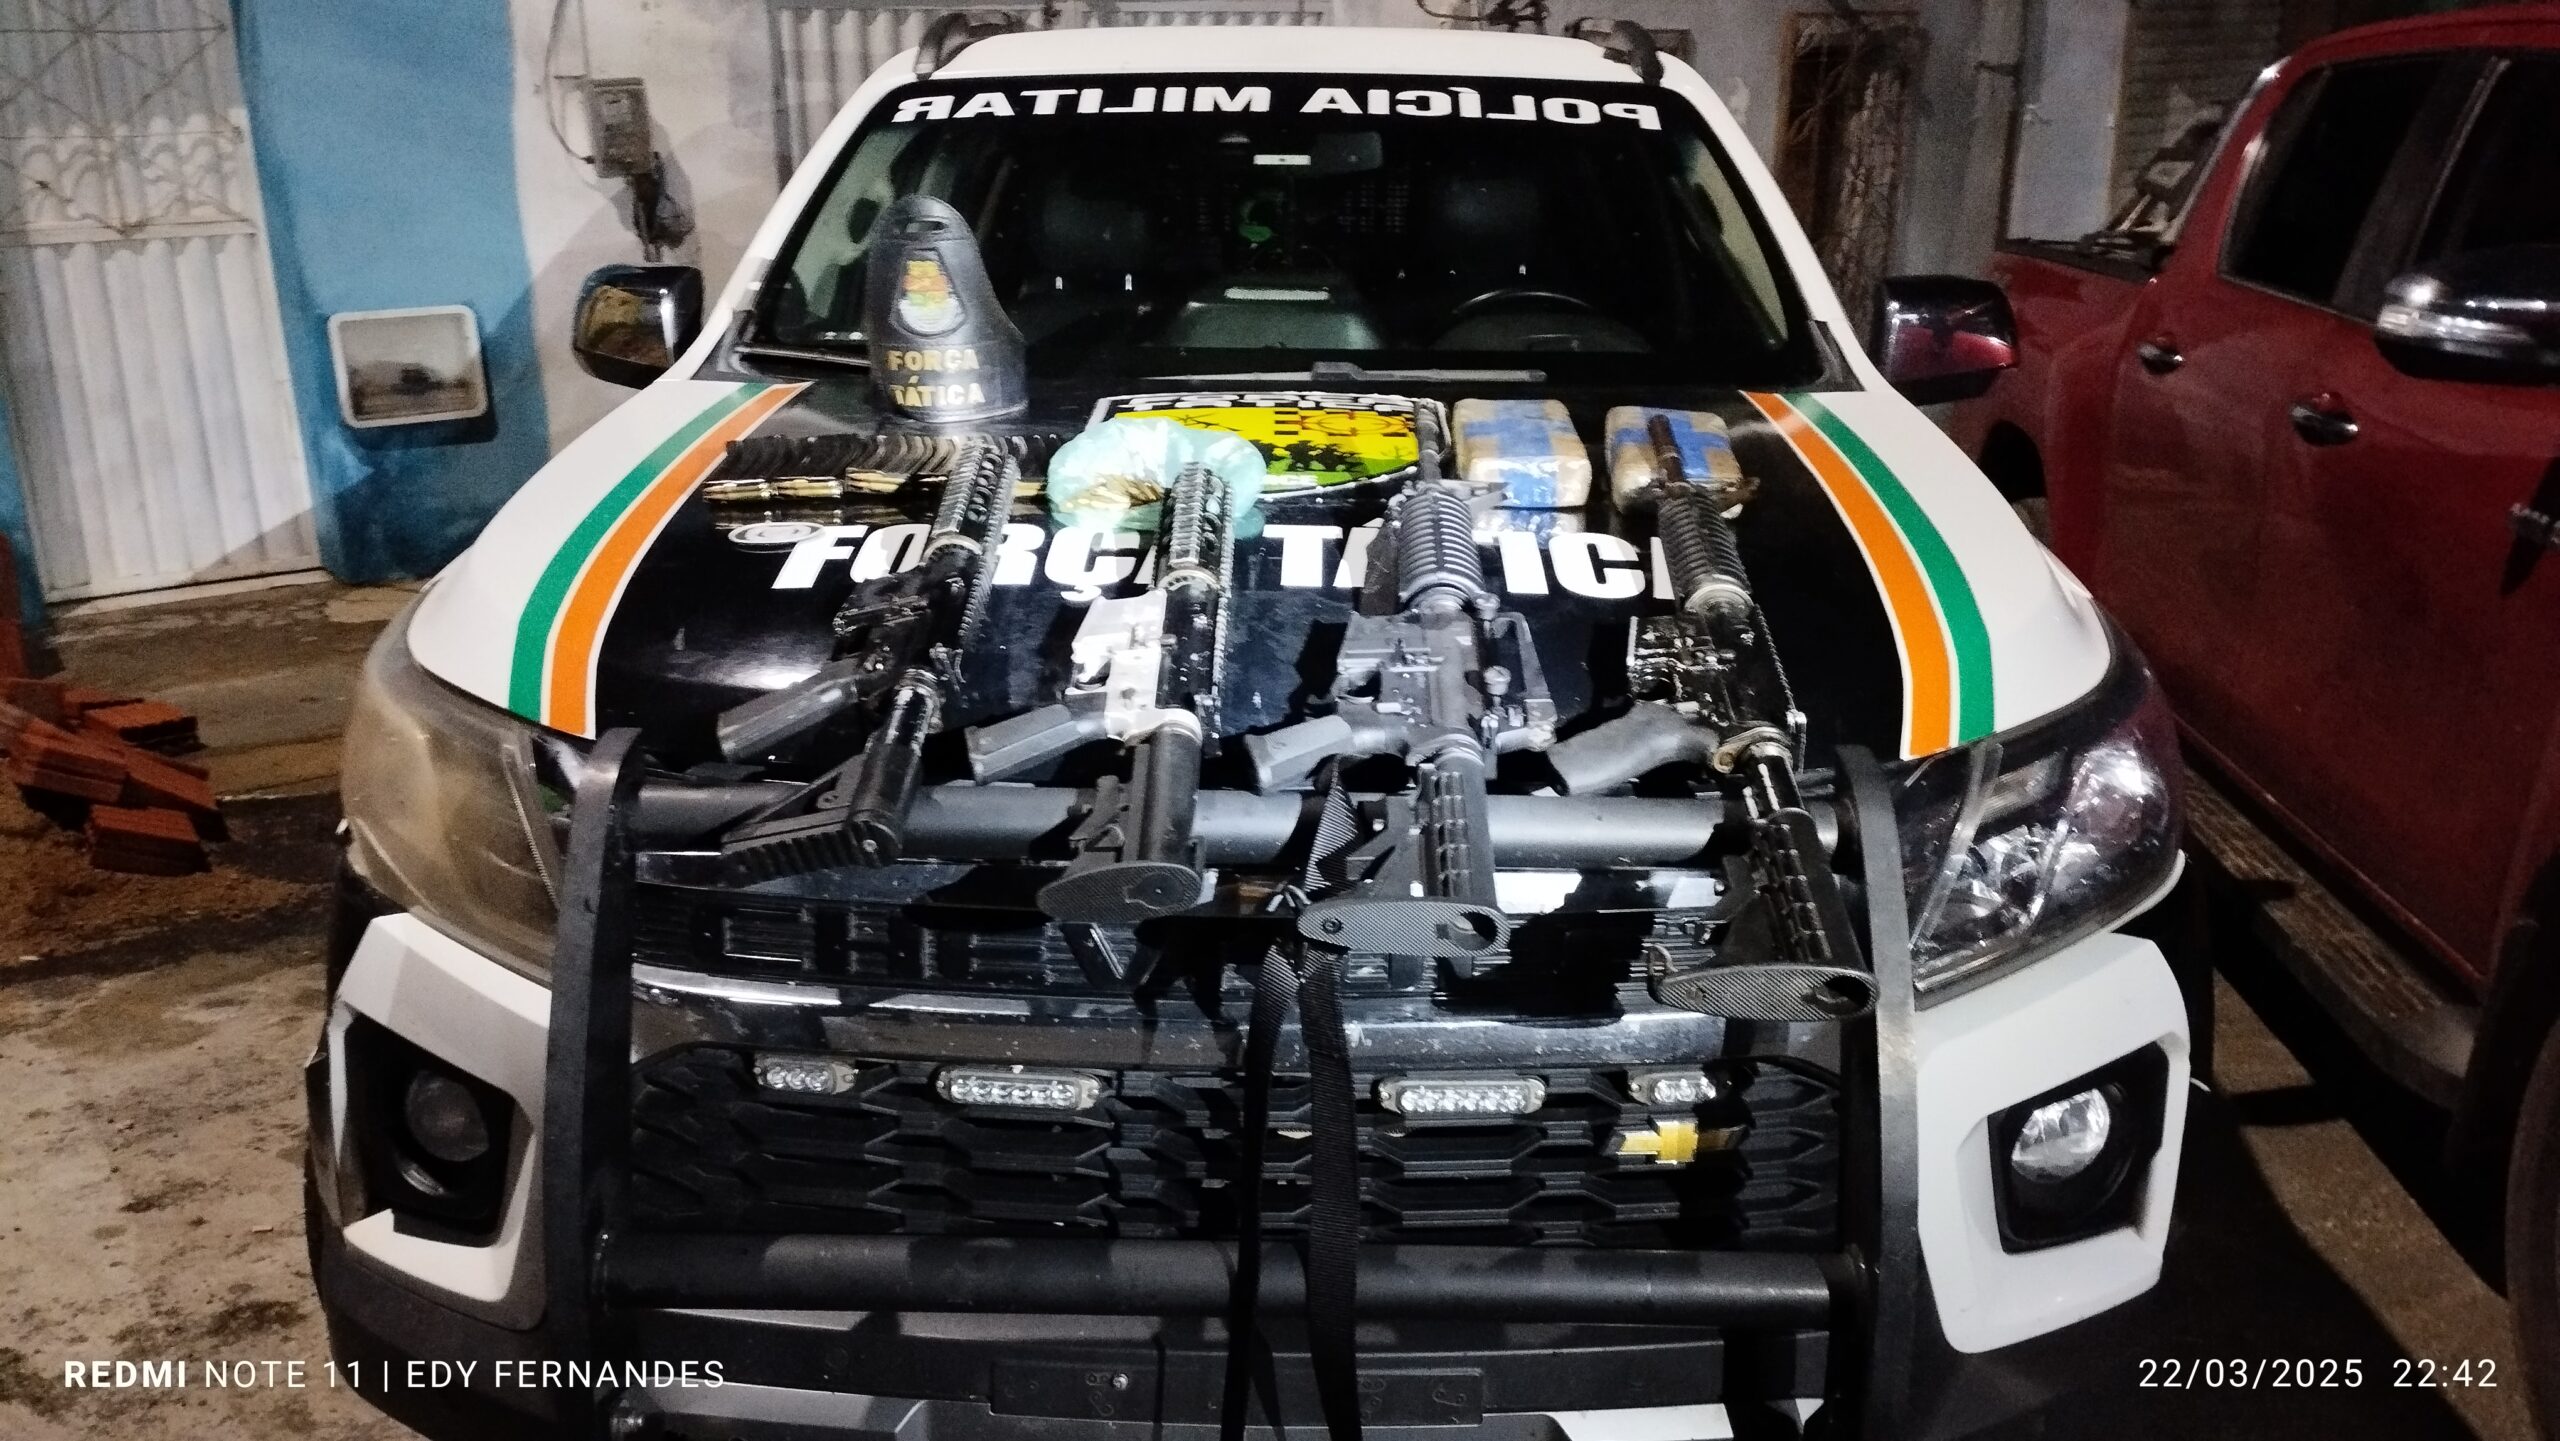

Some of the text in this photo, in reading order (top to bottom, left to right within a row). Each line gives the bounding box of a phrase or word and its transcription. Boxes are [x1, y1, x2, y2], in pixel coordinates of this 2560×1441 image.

[885, 348, 981, 374] FORÇA
[888, 375, 987, 407] TÁTICA
[771, 522, 1158, 600] FORÇ
